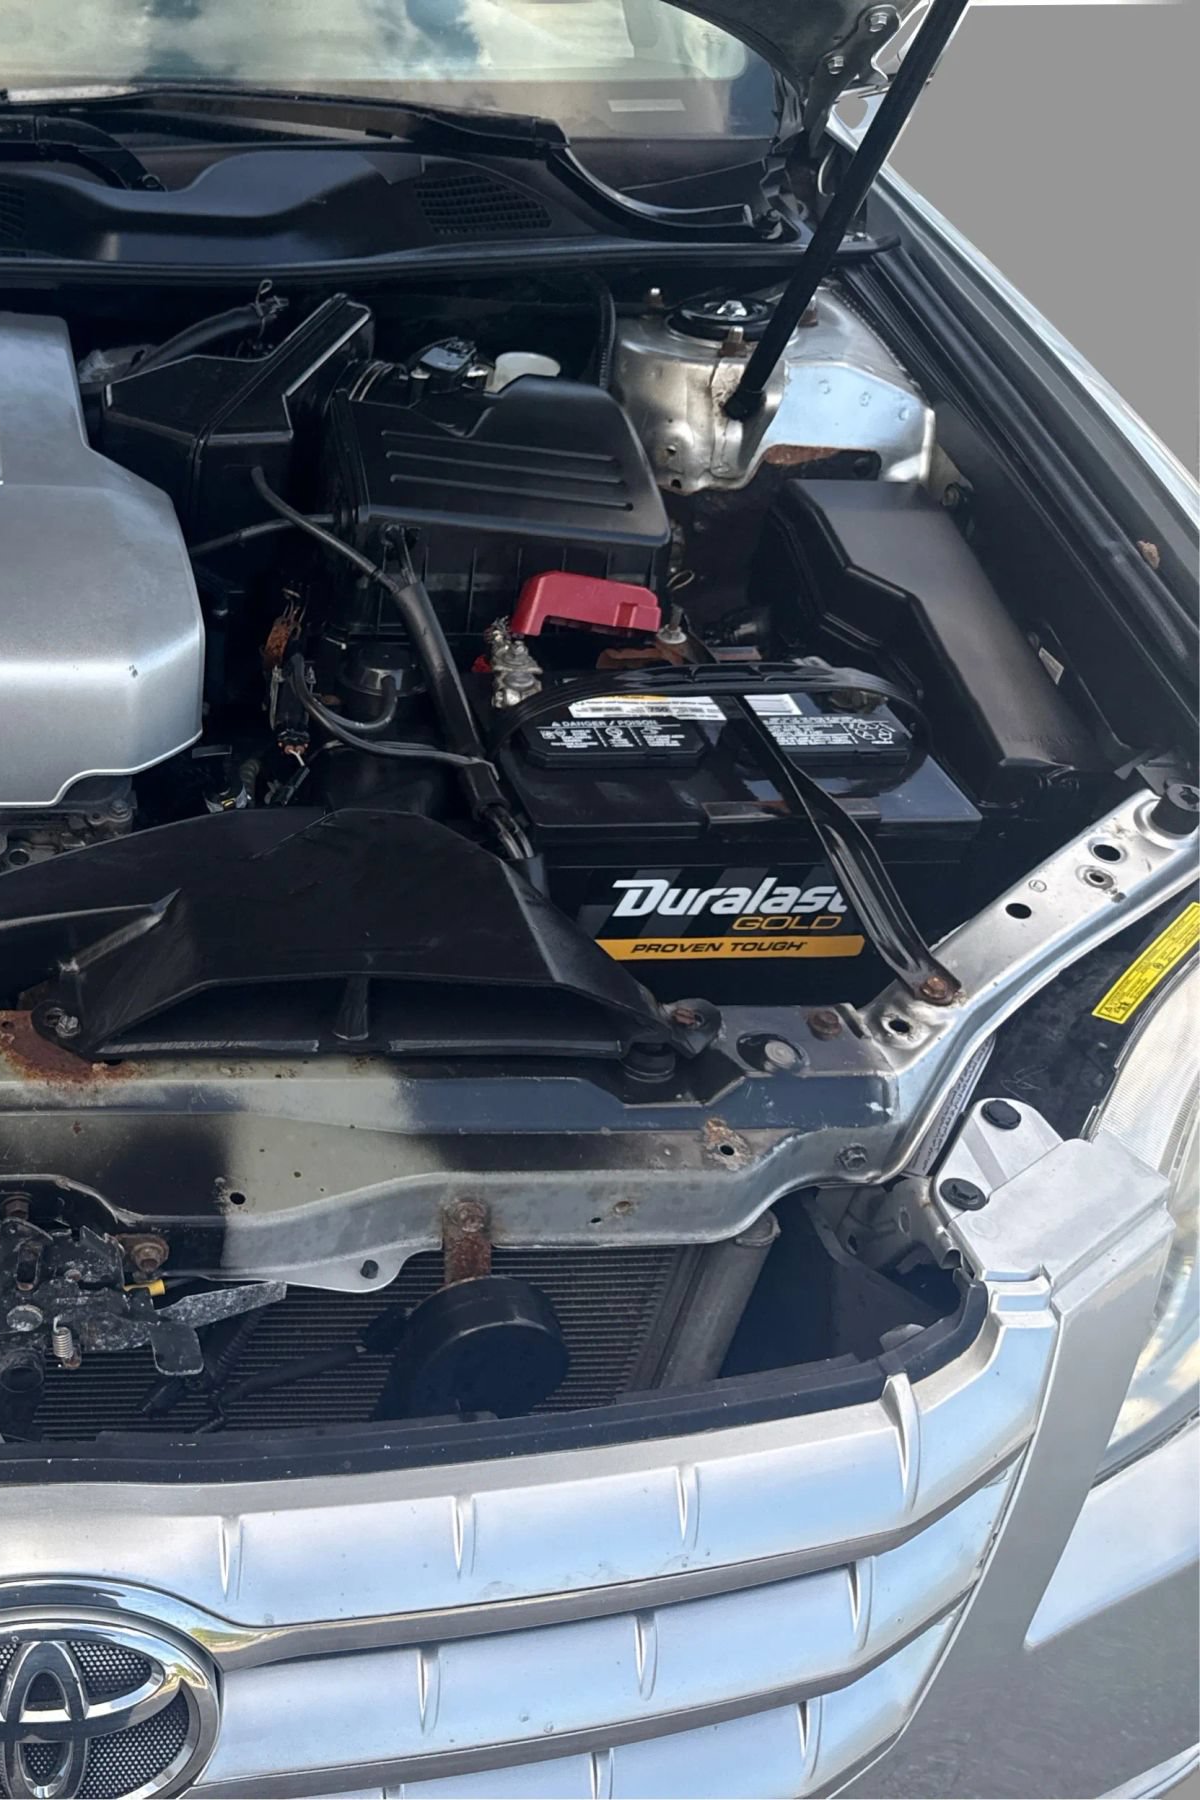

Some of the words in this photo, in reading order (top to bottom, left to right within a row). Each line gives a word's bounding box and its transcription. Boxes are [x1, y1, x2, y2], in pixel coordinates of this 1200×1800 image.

[732, 916, 842, 931] GOLD
[631, 943, 725, 954] PROVEN
[730, 941, 803, 952] TOUGH
